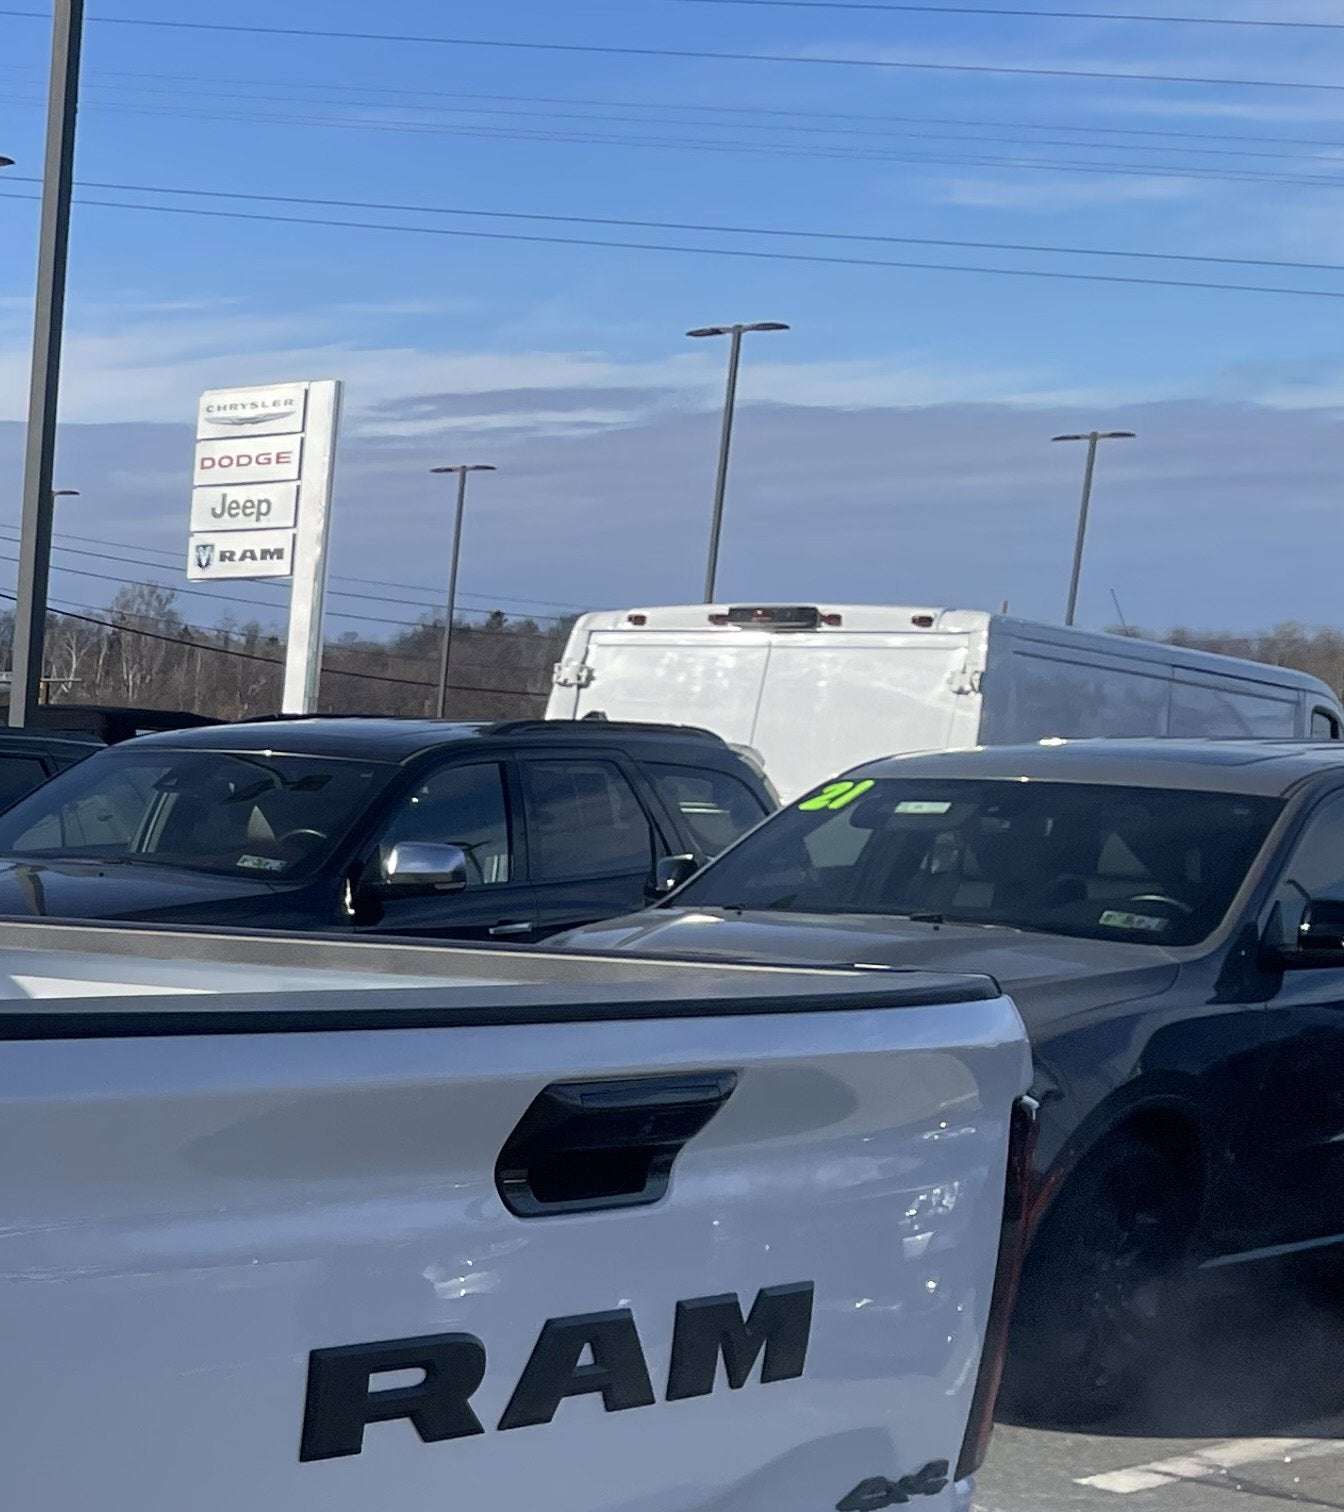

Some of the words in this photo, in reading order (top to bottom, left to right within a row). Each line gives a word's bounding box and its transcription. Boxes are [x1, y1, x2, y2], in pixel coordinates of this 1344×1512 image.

[205, 398, 294, 413] CHRYSLER
[199, 451, 293, 470] DODGE
[211, 493, 272, 522] Jeep
[219, 547, 285, 563] RAM
[798, 779, 875, 811] 21
[299, 1280, 815, 1463] RAM
